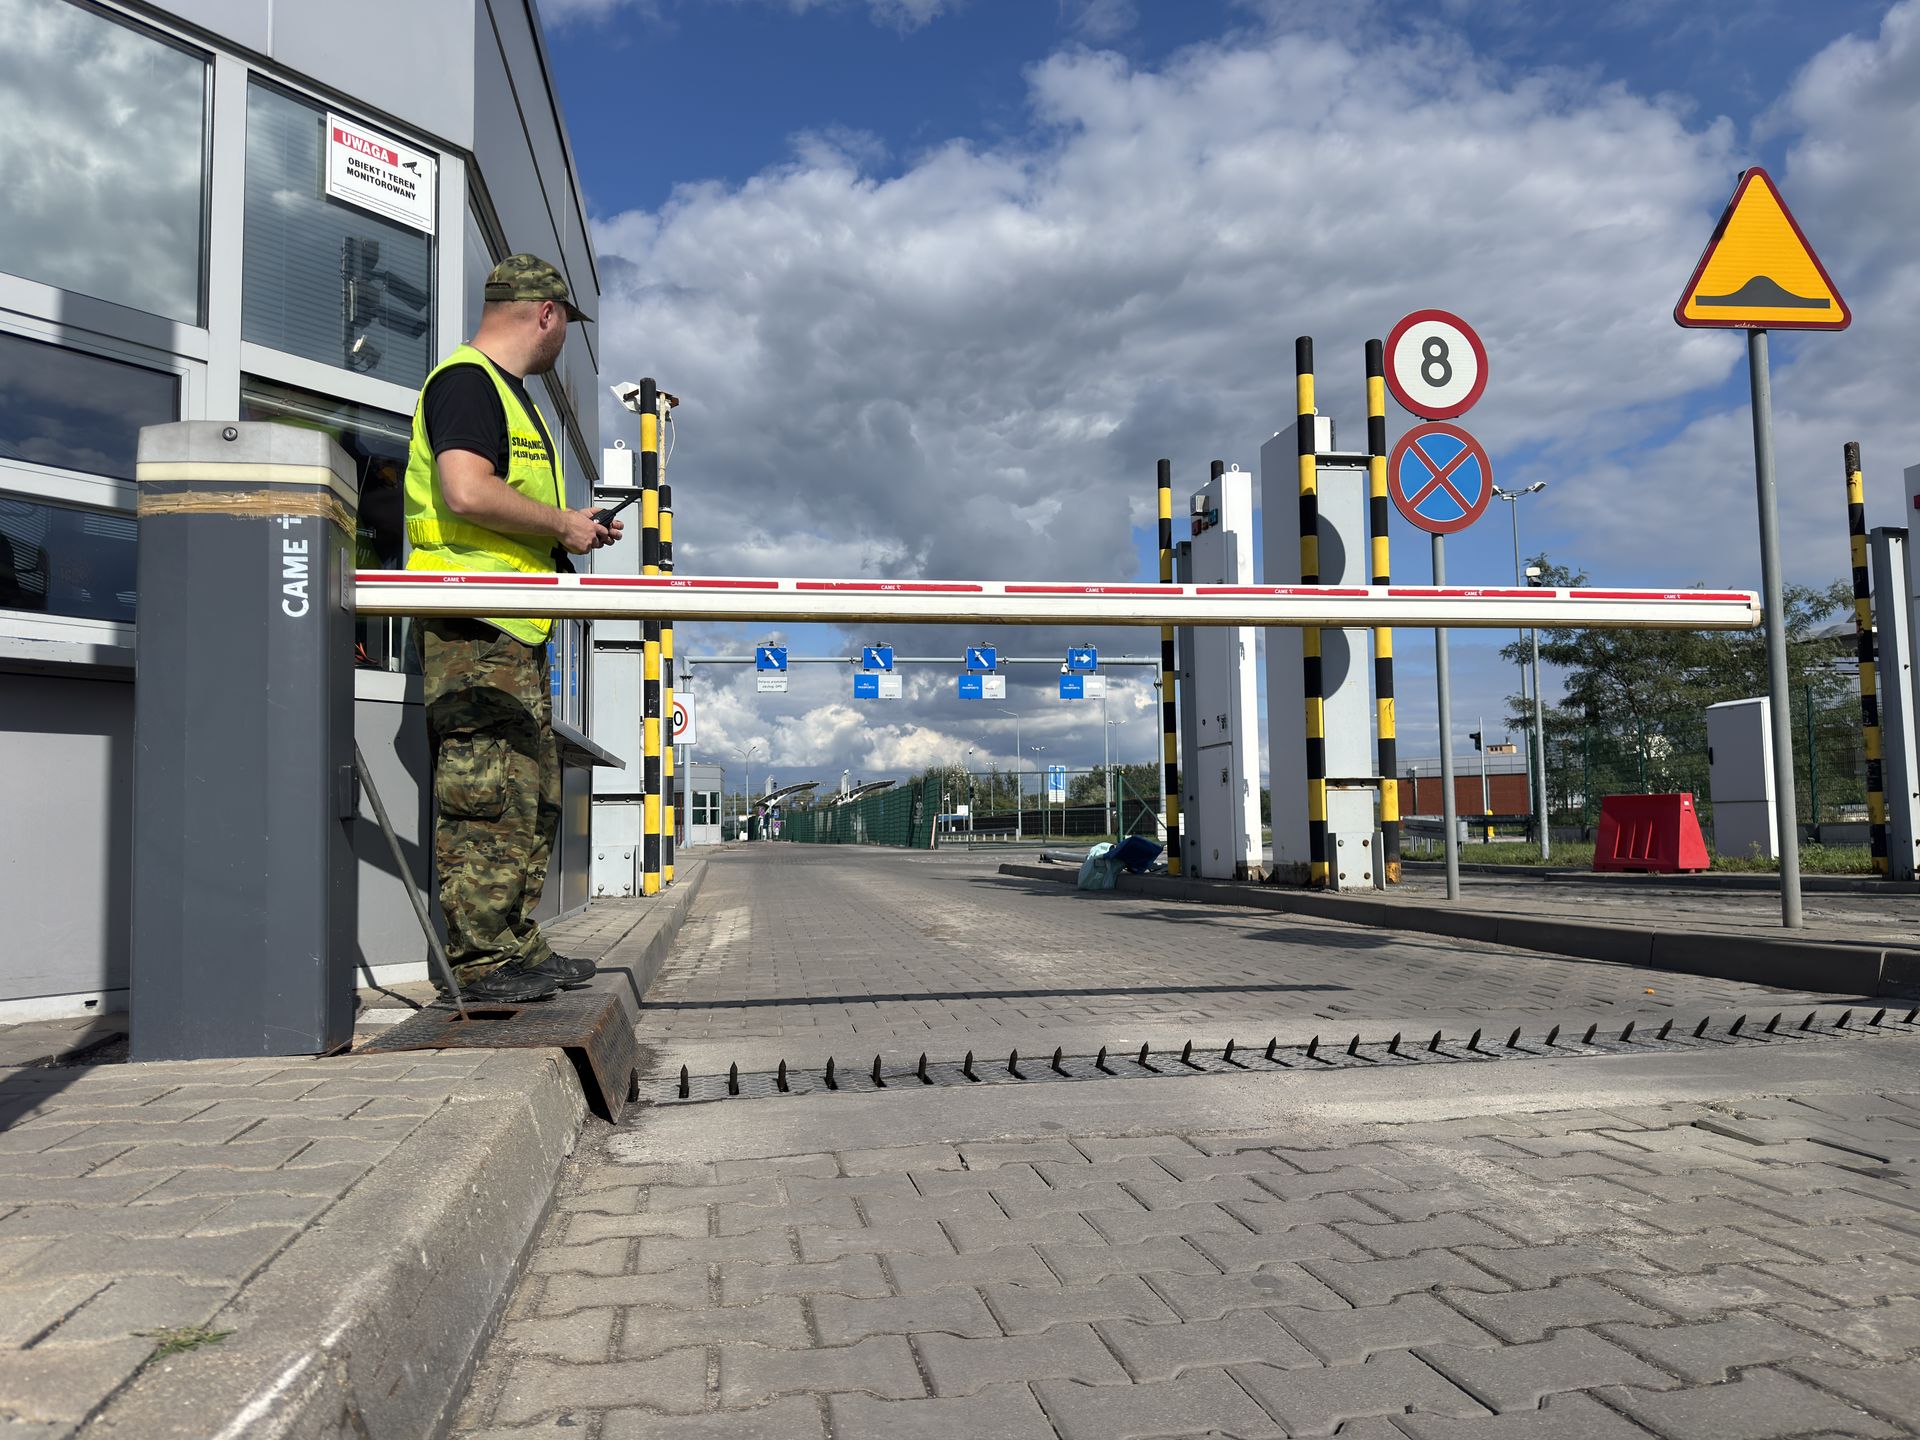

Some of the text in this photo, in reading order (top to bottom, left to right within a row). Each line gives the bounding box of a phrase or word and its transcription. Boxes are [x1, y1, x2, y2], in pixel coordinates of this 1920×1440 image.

[342, 131, 390, 163] UWAGA
[346, 167, 417, 200] MONITOROWANY
[348, 157, 380, 175] OBIEKT
[388, 173, 415, 190] TEREN
[1421, 336, 1452, 387] 8
[282, 539, 309, 617] CAME
[674, 711, 683, 726] 0
